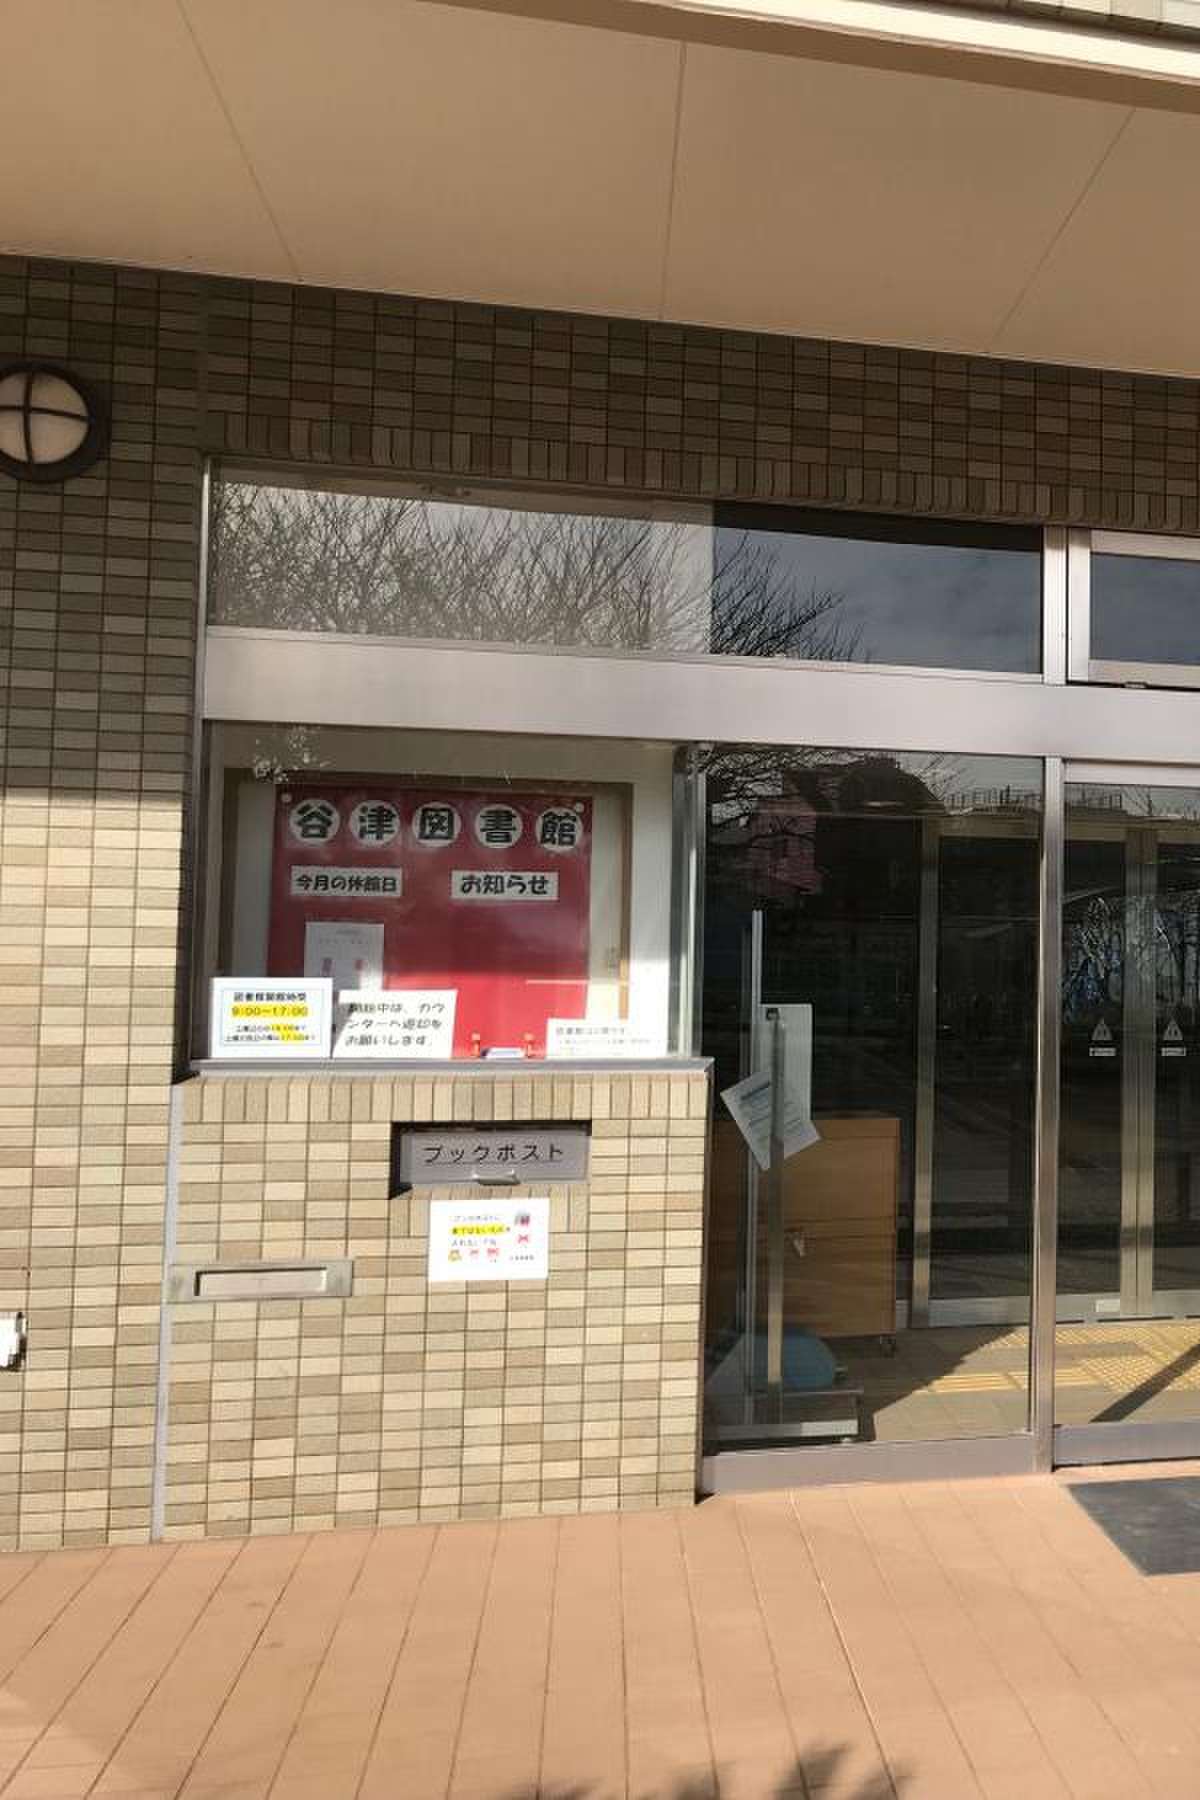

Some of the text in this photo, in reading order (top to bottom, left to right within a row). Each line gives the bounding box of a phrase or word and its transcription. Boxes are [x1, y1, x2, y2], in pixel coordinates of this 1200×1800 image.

[295, 803, 579, 848] 谷津図書館
[295, 874, 398, 892] 今月の休館日
[460, 873, 550, 895] お知らせ
[422, 1144, 565, 1163] ブックポスト
